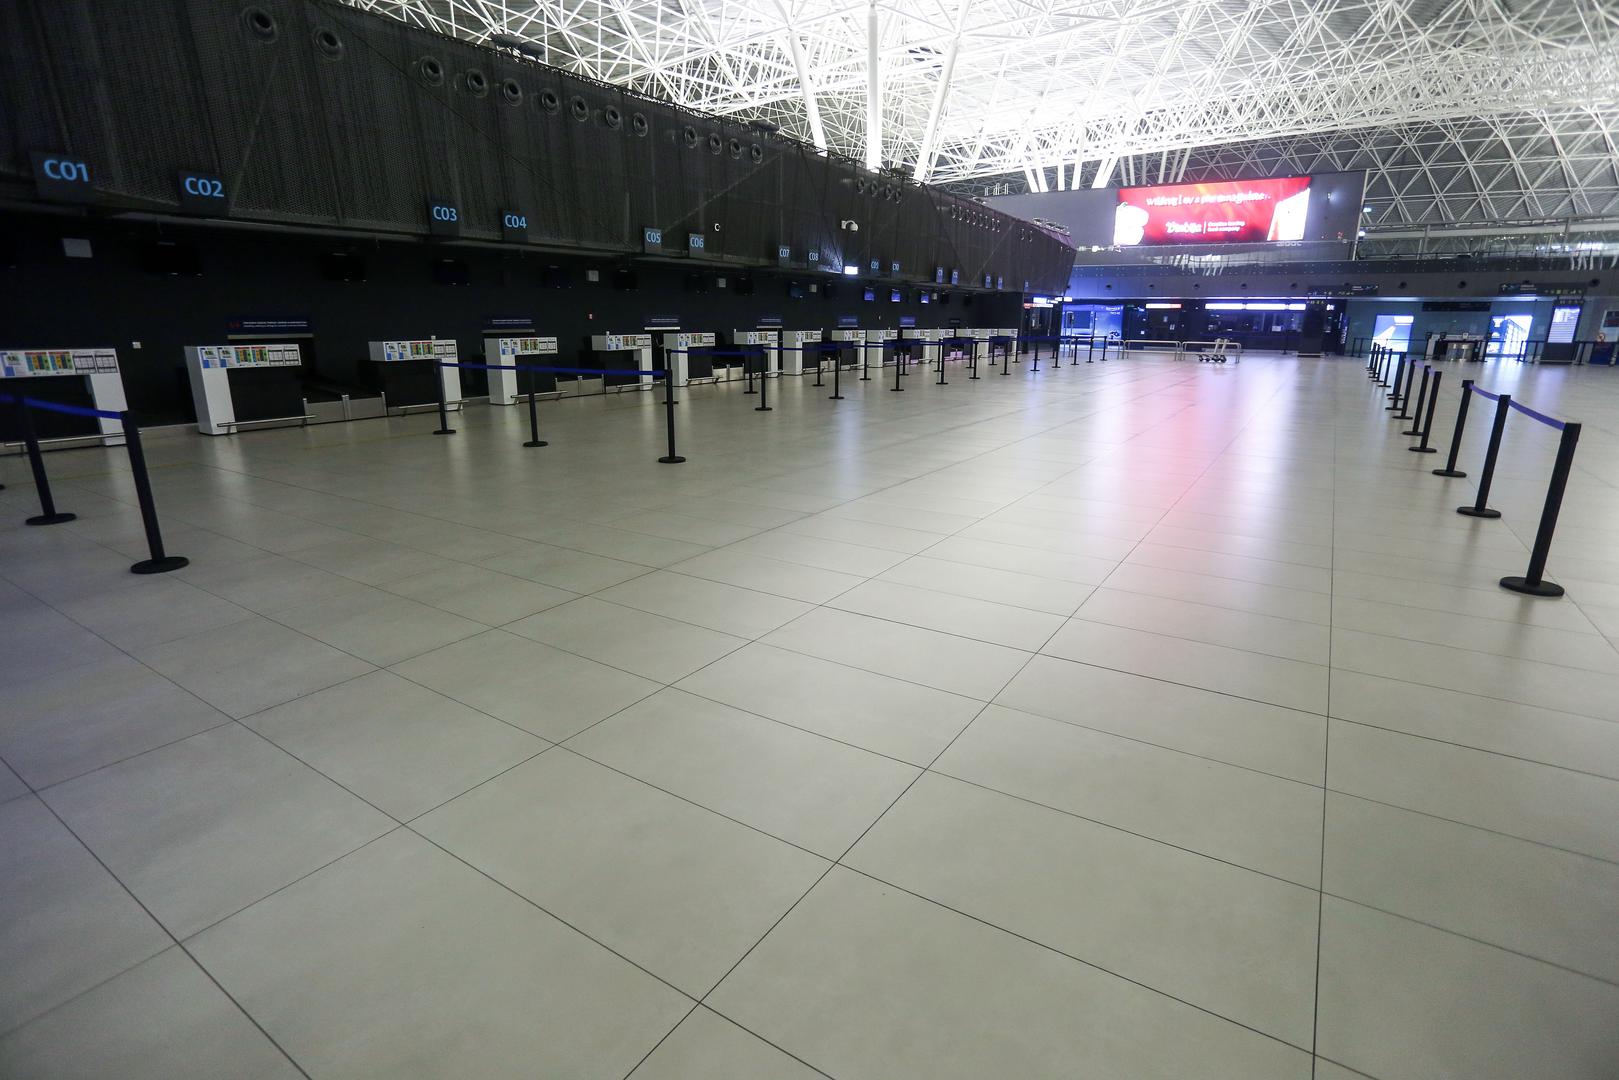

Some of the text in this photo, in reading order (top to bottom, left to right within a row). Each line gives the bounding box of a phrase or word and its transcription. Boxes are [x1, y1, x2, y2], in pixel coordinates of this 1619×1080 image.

[44, 159, 89, 182] C01
[184, 177, 224, 198] C02
[432, 206, 458, 222] C03
[504, 215, 528, 229] C04
[645, 231, 661, 244] C05
[690, 237, 704, 248] C06
[779, 248, 790, 257] C07
[808, 252, 819, 262] C08
